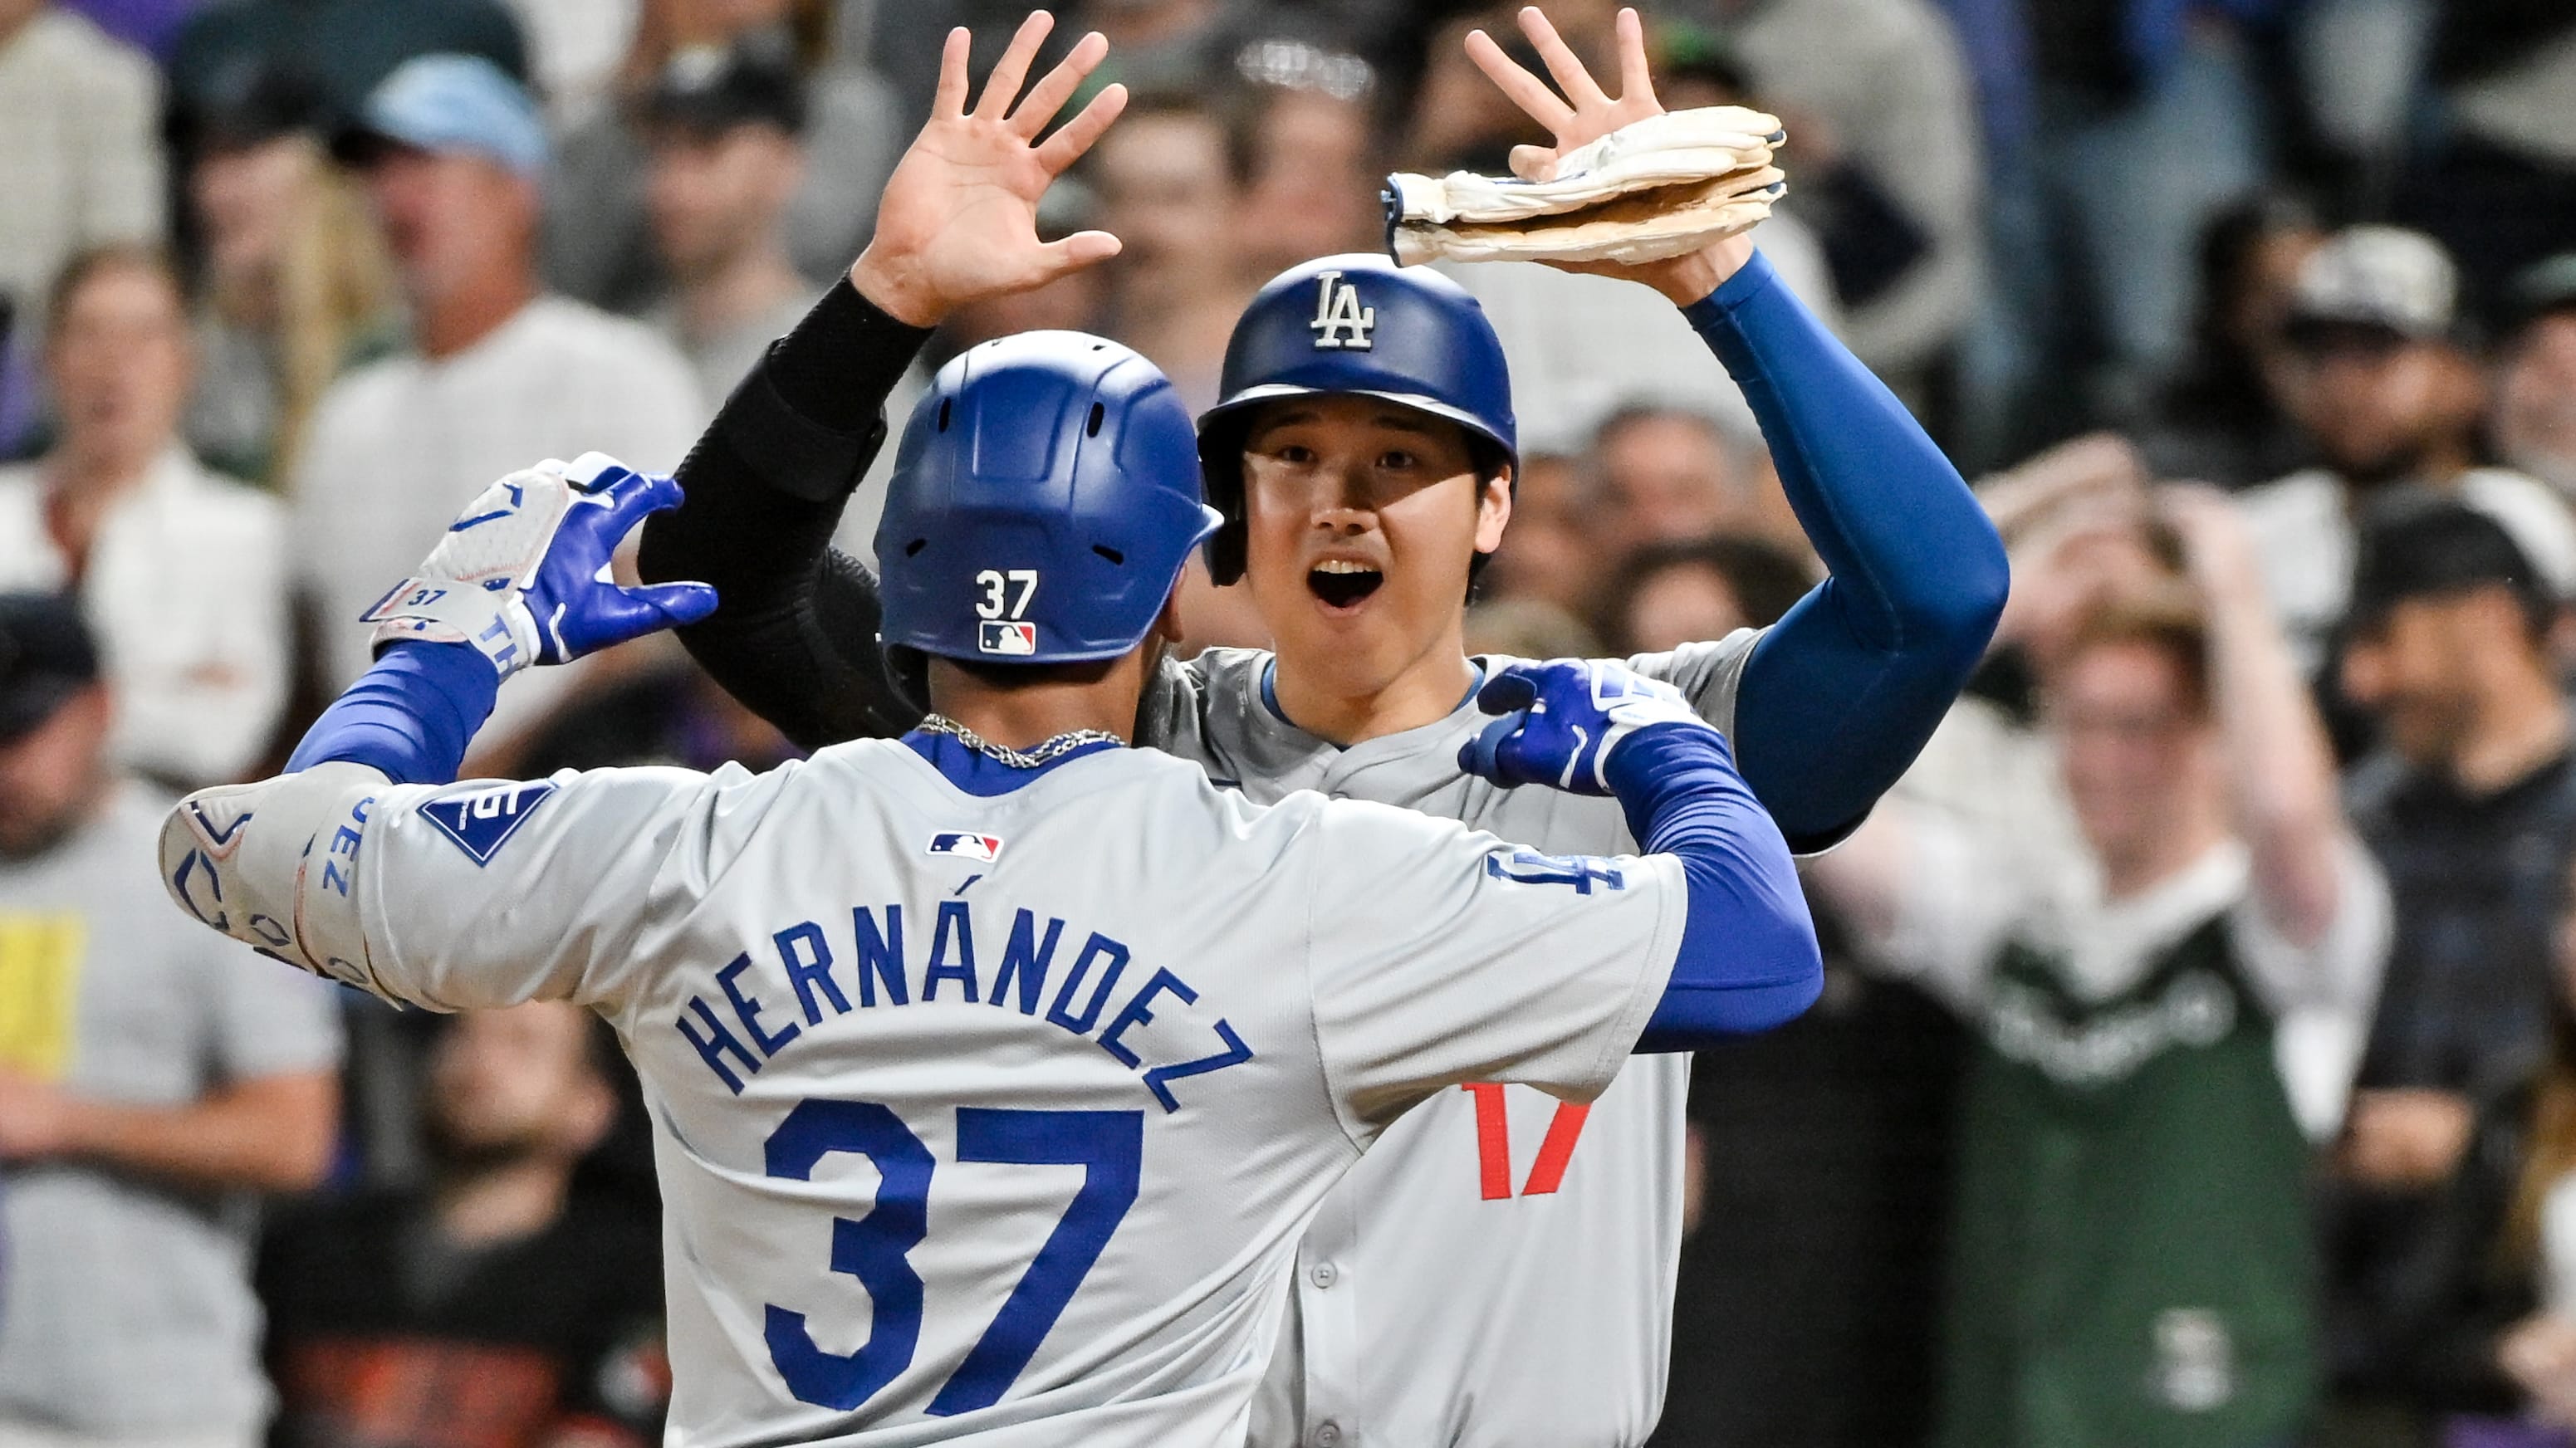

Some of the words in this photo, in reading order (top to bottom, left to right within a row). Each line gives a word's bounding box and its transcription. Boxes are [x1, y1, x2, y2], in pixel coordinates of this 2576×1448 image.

[1310, 271, 1374, 348] LA
[408, 589, 447, 605] 37
[975, 570, 1038, 619] 37
[675, 874, 1254, 1113] HERNÁNDEZ
[764, 1098, 1144, 1416] 37
